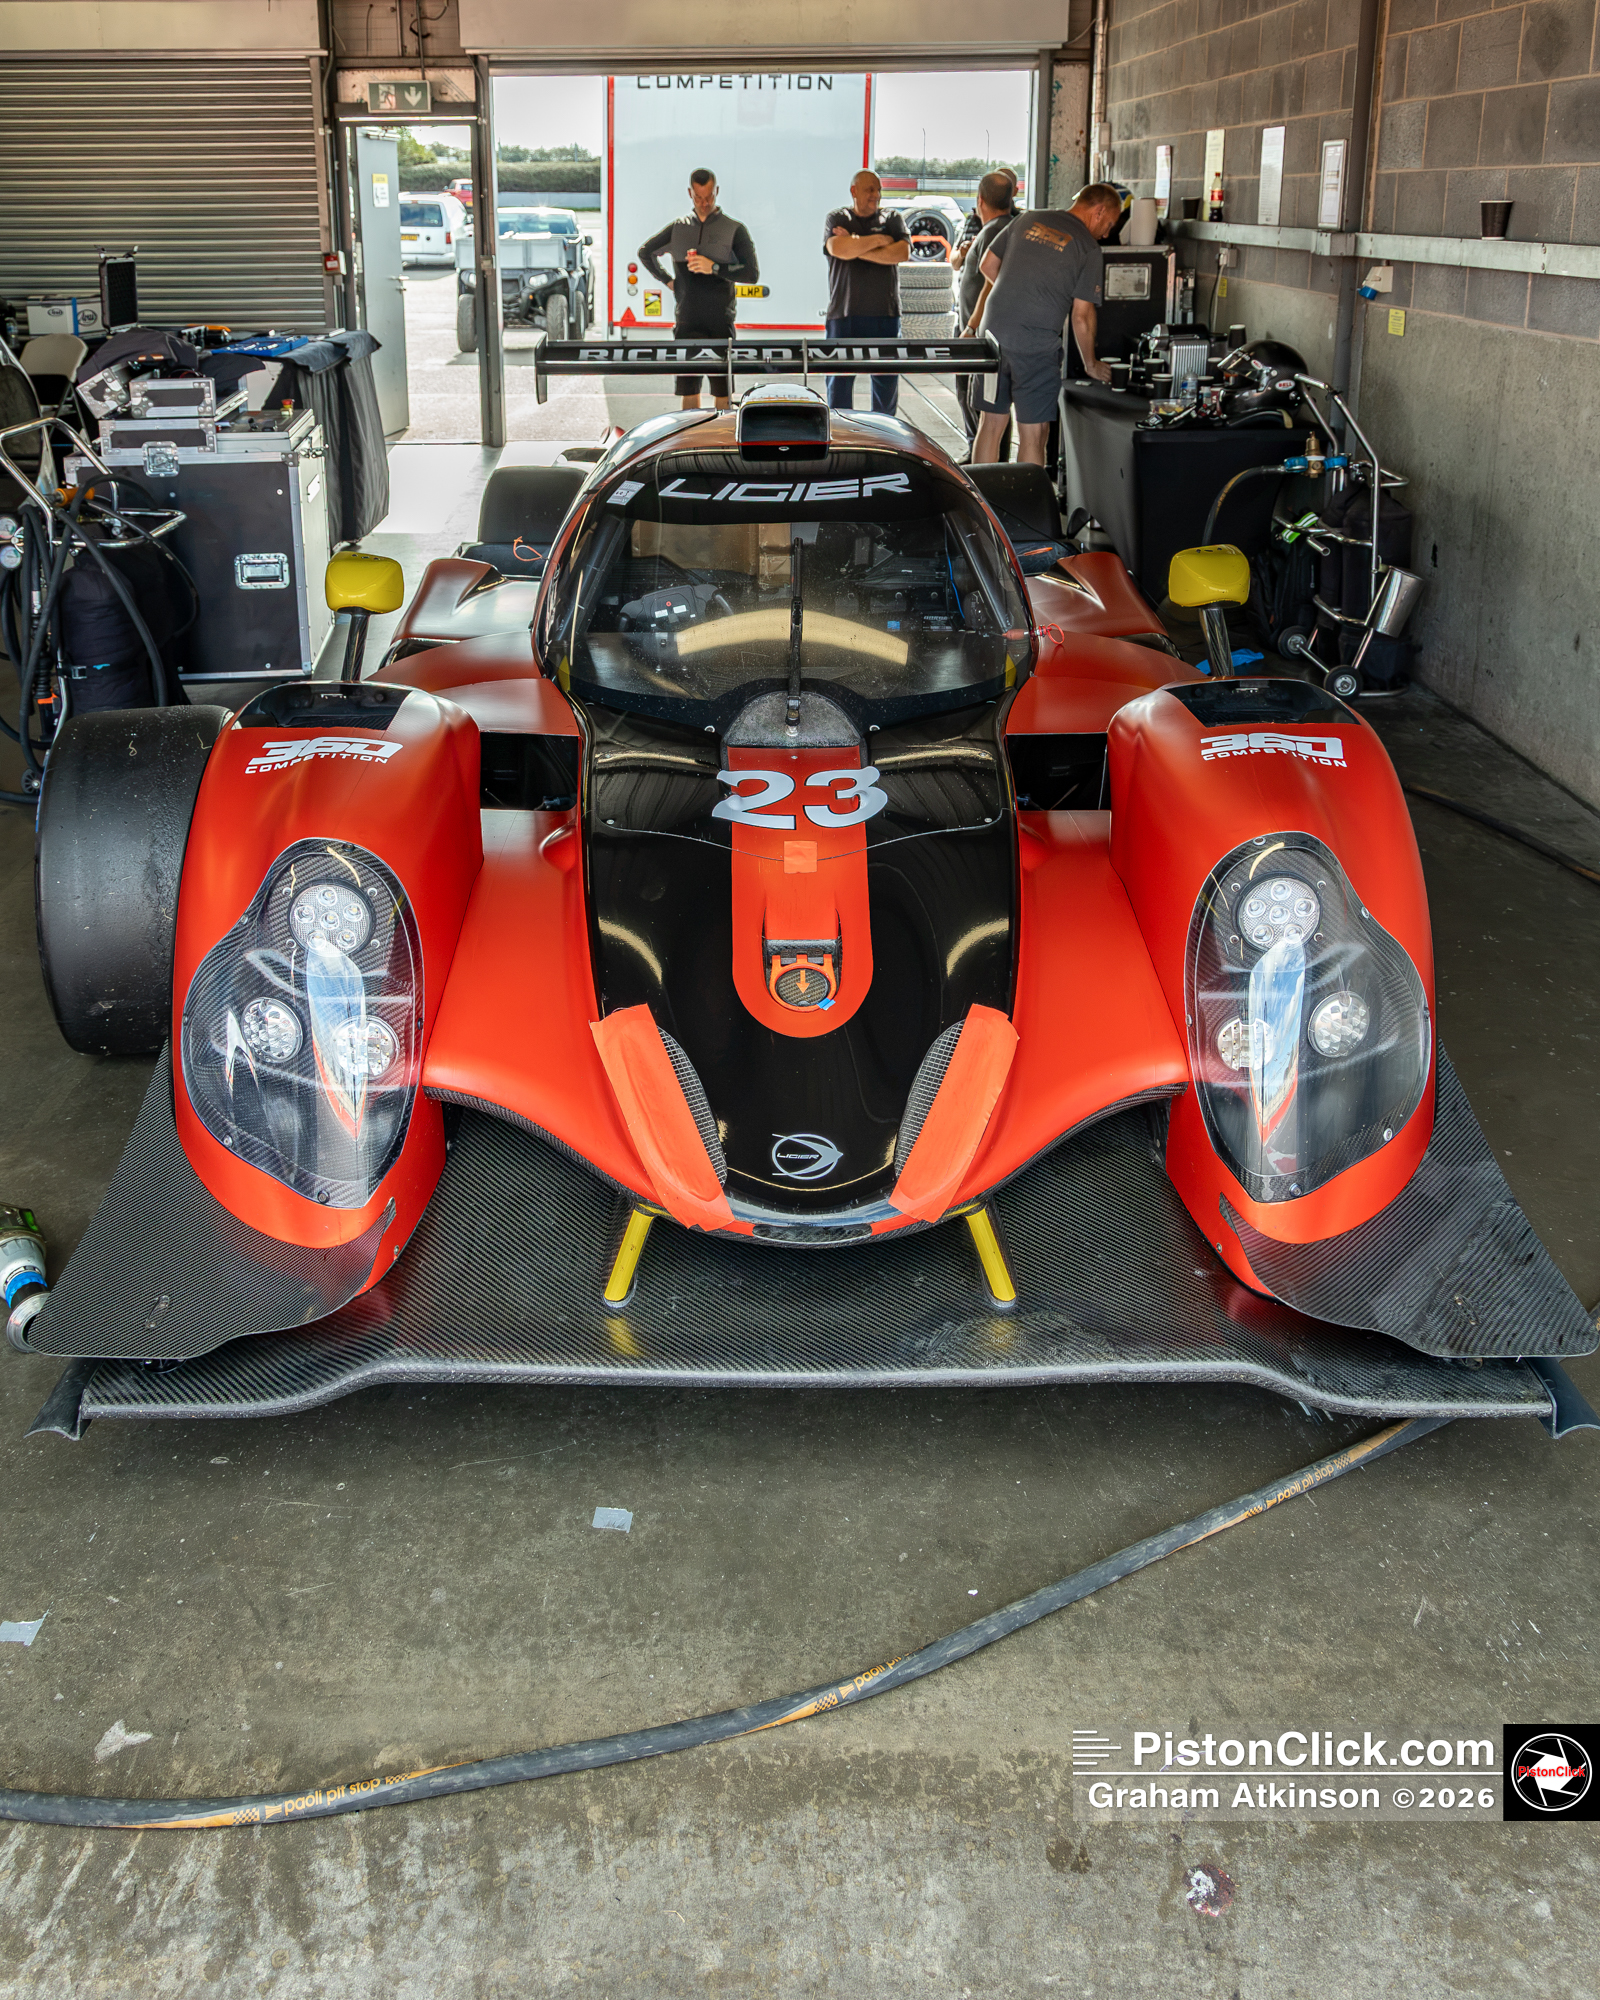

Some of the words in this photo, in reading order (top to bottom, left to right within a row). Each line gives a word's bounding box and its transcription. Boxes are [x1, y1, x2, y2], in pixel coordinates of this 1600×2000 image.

[637, 75, 833, 90] COMPETITION
[578, 348, 793, 361] RICHARD
[803, 347, 952, 361] MILLE
[658, 472, 912, 502] LIGIER
[248, 736, 403, 765] 360
[1200, 732, 1344, 759] 360
[1203, 748, 1348, 768] COMPETITION
[245, 752, 388, 774] COMPETITION
[711, 765, 888, 830] 23
[776, 1152, 820, 1160] LIGIER
[1276, 1480, 1301, 1504] paoli
[1301, 1473, 1314, 1492] pit
[1314, 1463, 1335, 1482] stop
[853, 1664, 885, 1691] paoli
[284, 1790, 323, 1816] paoli
[326, 1785, 346, 1806] pit
[349, 1778, 381, 1795] stop
